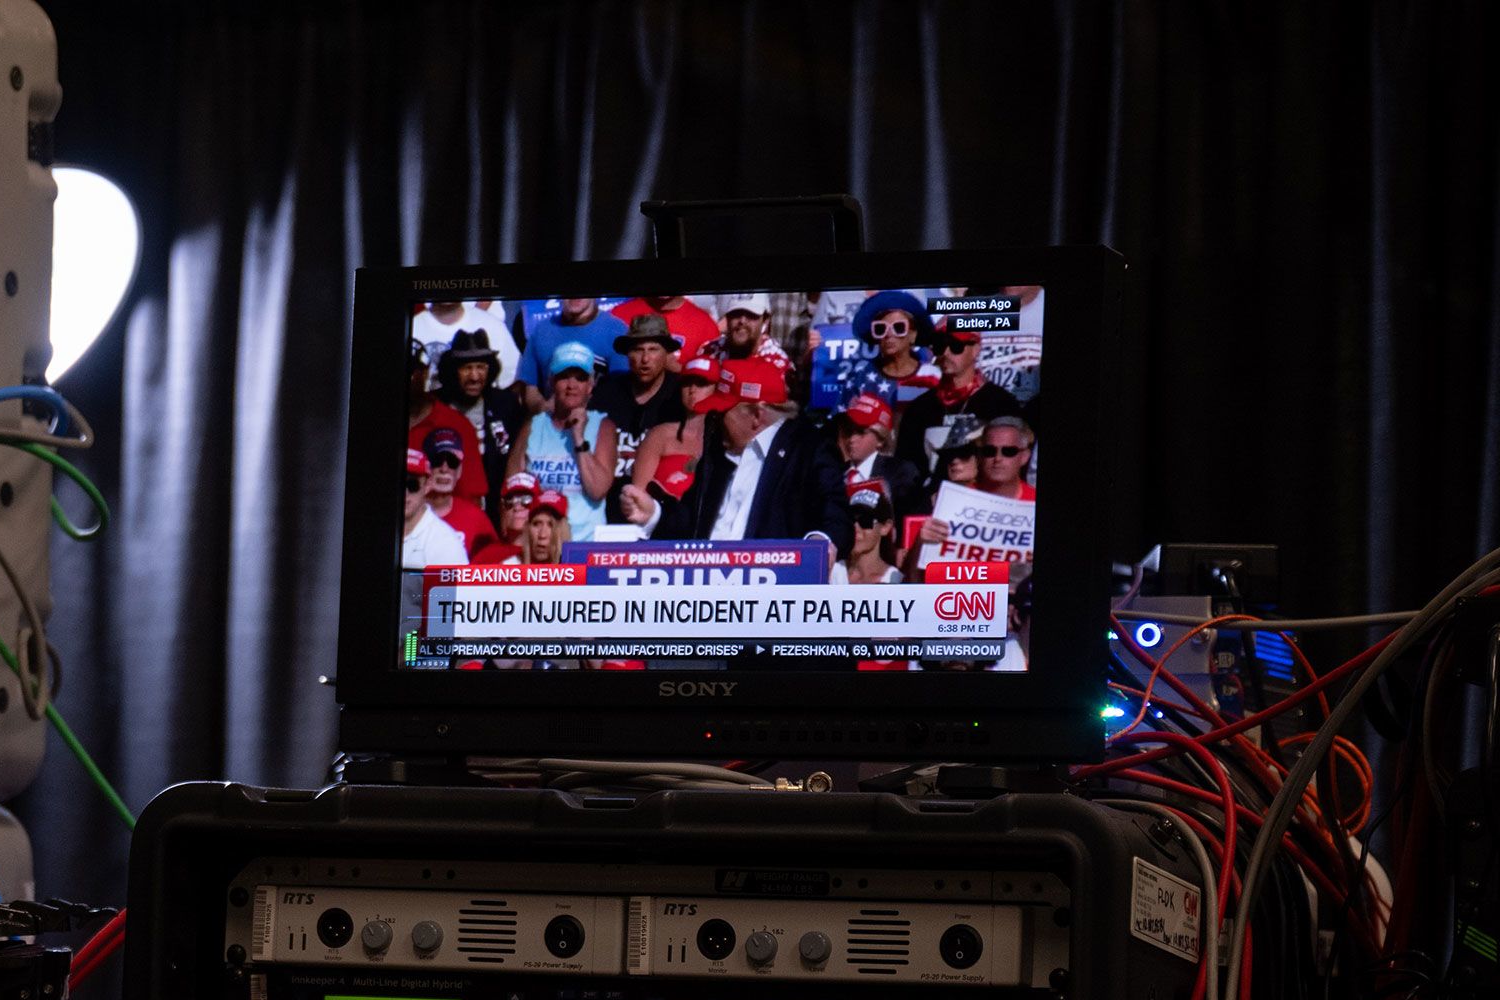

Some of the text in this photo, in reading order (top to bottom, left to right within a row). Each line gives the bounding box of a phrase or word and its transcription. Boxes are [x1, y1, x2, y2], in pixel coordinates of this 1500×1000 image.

[412, 279, 480, 290] TRIMASTER
[936, 299, 1011, 312] Moments Ago
[956, 317, 1011, 329] Butler, PA
[531, 460, 576, 473] MEAN
[534, 473, 582, 485] WEETS
[954, 507, 1033, 528] JOE BIDEN
[949, 521, 1032, 547] YOU'RE
[593, 551, 796, 565] TEXT PENNSYLVANIA TO 88022
[440, 567, 574, 582] BREAKING NEWS
[946, 566, 988, 580] LIVE
[438, 600, 915, 623] TRUMP INJURED IN INCIDENT AT PA RALLY
[934, 591, 996, 621] CNN
[937, 624, 990, 633] 6:38 PM ET
[436, 645, 506, 656] SUPREMACY
[508, 645, 563, 656] COUPLED
[565, 645, 595, 656] WITH
[598, 645, 694, 656] MANUFACTURED
[696, 645, 744, 656] CRISES"
[772, 645, 850, 657] PEZESHKIAN,
[853, 645, 871, 657] 69,
[874, 645, 905, 656] WON
[927, 645, 1000, 656] NEWSROOM
[658, 681, 738, 697] SONY
[283, 892, 315, 905] RTS
[663, 903, 698, 916] RTS
[291, 975, 336, 987] Innkeeper
[352, 977, 399, 988] Multi-Line
[400, 978, 431, 991] Digital
